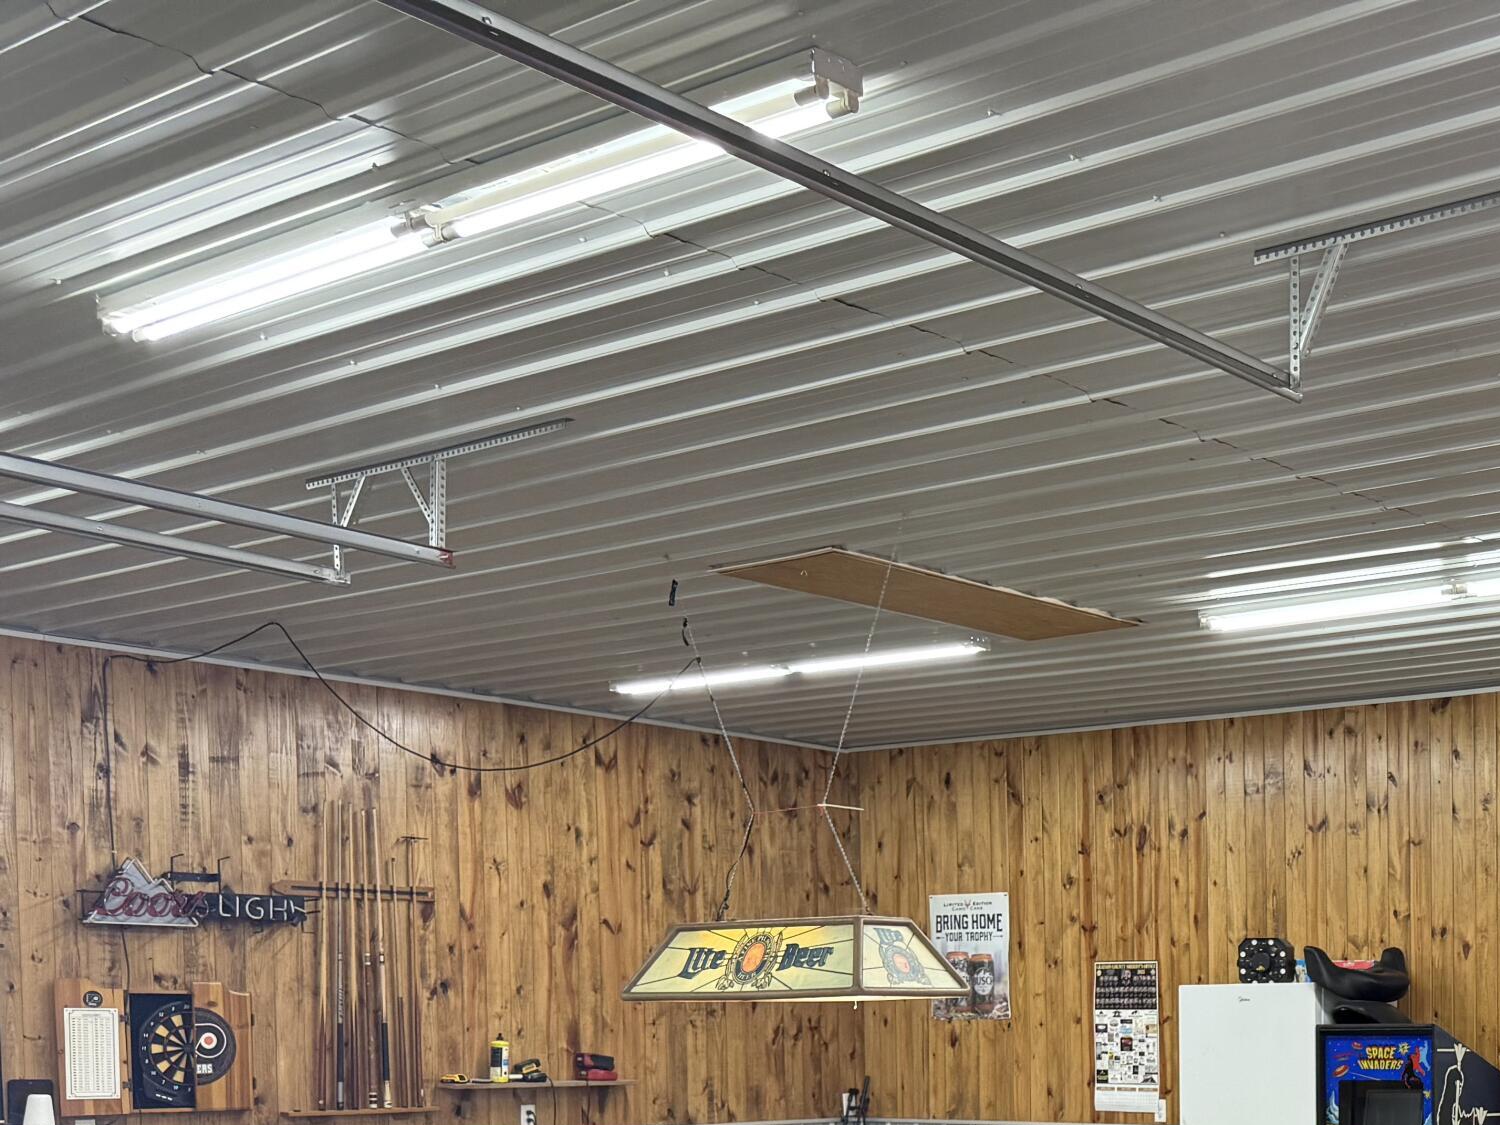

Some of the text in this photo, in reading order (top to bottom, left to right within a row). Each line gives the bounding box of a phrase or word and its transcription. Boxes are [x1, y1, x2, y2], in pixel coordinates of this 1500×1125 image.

[936, 913, 1003, 933] BRING HOME
[945, 931, 993, 942] YOUR TROPHY
[678, 947, 728, 980] Lite
[776, 943, 835, 972] Beer
[1365, 1046, 1396, 1059] SPACE
[1357, 1060, 1404, 1070] INVADERS
